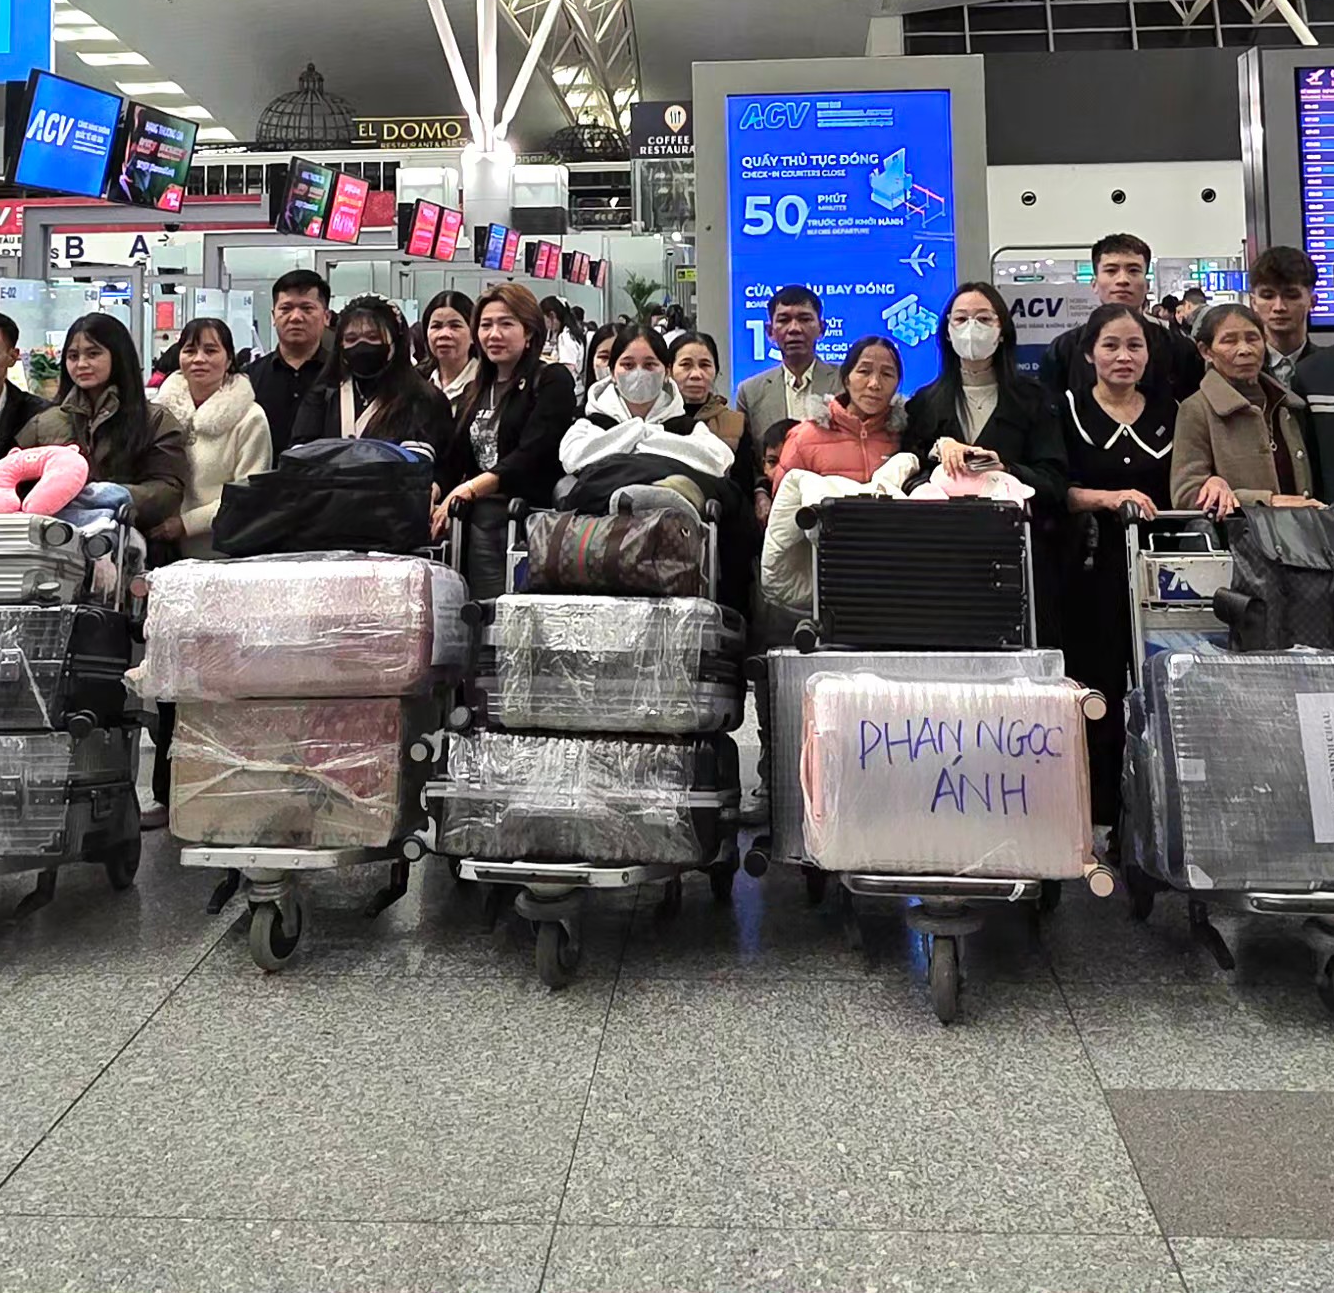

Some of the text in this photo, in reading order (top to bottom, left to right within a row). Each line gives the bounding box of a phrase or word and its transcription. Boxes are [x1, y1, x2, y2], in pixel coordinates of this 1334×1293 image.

[739, 101, 811, 130] ACV
[26, 109, 75, 146] ACV
[359, 121, 462, 140] EL DOMO
[648, 135, 690, 145] COFFEE
[640, 145, 695, 155] RESTAURA
[780, 152, 808, 166] THỦ
[810, 154, 837, 168] TỤC
[839, 152, 879, 165] ĐÓNG
[818, 192, 847, 203] PHÚT
[742, 195, 809, 236] 50
[878, 217, 904, 226] HÀNH
[66, 236, 84, 259] B
[129, 235, 150, 258] A
[0, 287, 17, 299] E-02
[745, 283, 774, 297] CỬA
[826, 285, 853, 295] BAY
[855, 282, 895, 295] ĐÓNG
[1010, 297, 1064, 317] ACV
[859, 716, 1064, 770] PHAN NGỌC
[930, 754, 1028, 815] ÁNH
